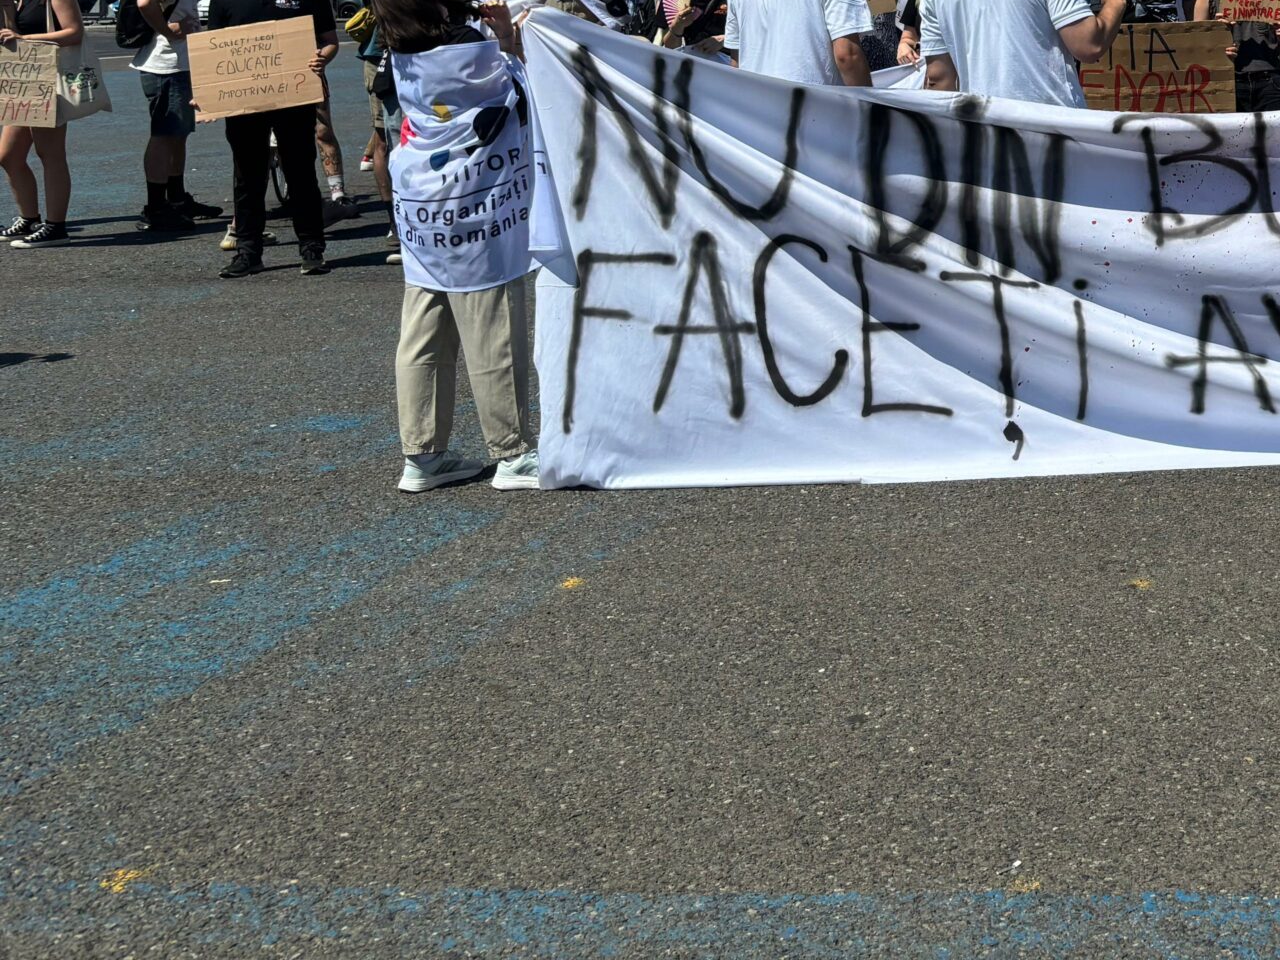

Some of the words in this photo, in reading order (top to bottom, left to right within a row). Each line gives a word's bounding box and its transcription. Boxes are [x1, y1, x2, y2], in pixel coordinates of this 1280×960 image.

[230, 42, 272, 56] PENTRU
[277, 82, 289, 94] EI
[294, 73, 306, 94] ?
[1114, 63, 1215, 113] DOAR
[442, 147, 521, 185] IITOR
[570, 42, 807, 230] NU
[860, 95, 1070, 286] DIN
[406, 228, 425, 248] din
[433, 206, 529, 248] România
